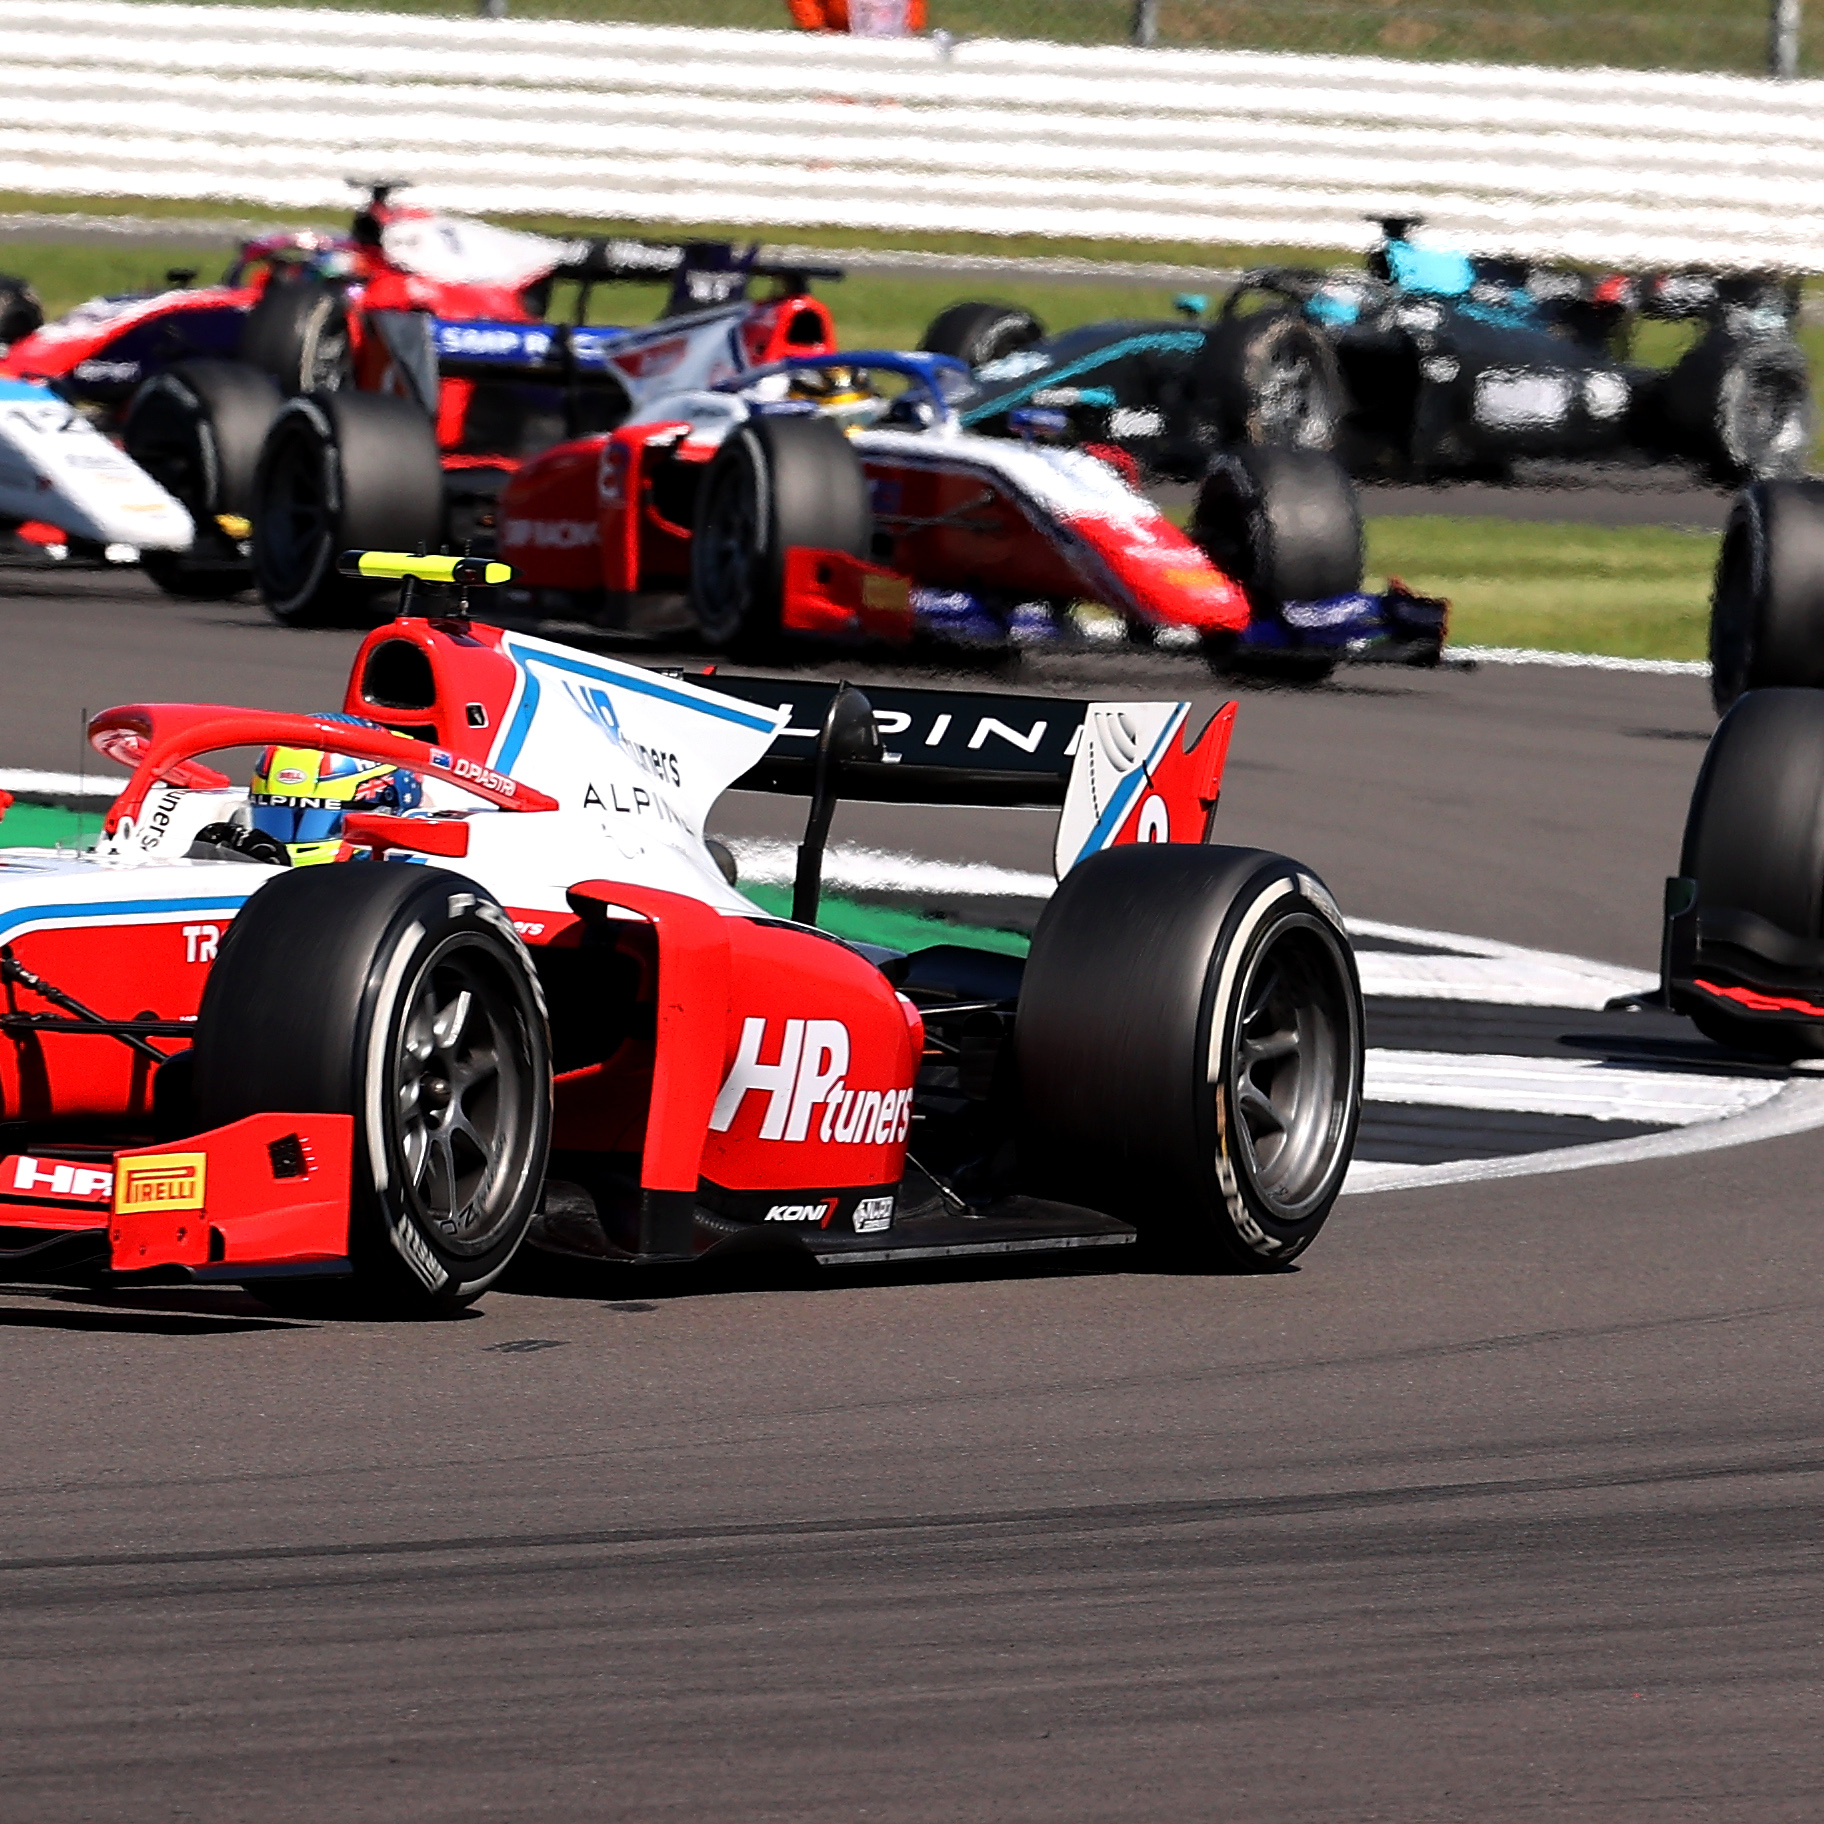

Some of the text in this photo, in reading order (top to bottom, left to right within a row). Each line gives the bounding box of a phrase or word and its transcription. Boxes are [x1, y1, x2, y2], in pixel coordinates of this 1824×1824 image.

[776, 702, 1086, 756] LPIN
[249, 792, 343, 810] ALPINE
[708, 1016, 914, 1145] HP tuners
[126, 1165, 198, 1204] PIRELLI
[764, 1205, 829, 1221] KONI
